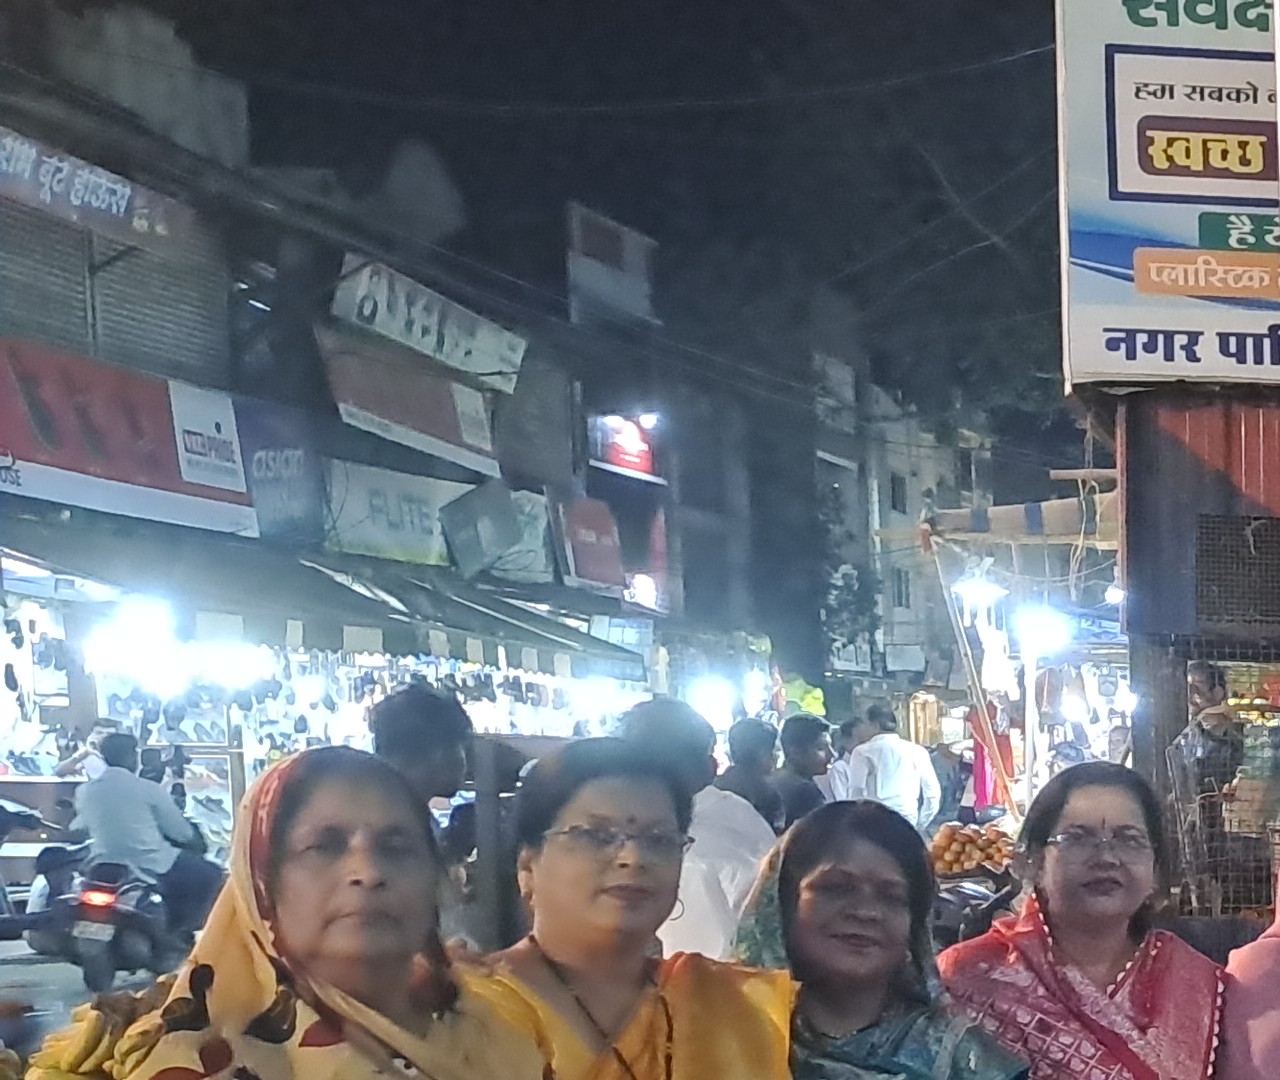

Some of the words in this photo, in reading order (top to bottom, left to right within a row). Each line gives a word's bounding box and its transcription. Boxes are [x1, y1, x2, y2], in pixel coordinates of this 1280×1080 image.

[1183, 81, 1260, 104] सबको
[1145, 129, 1267, 175] स्वच्छ
[1226, 214, 1255, 249] है
[1149, 256, 1270, 288] प्लास्टिक
[1103, 327, 1204, 363] नगर
